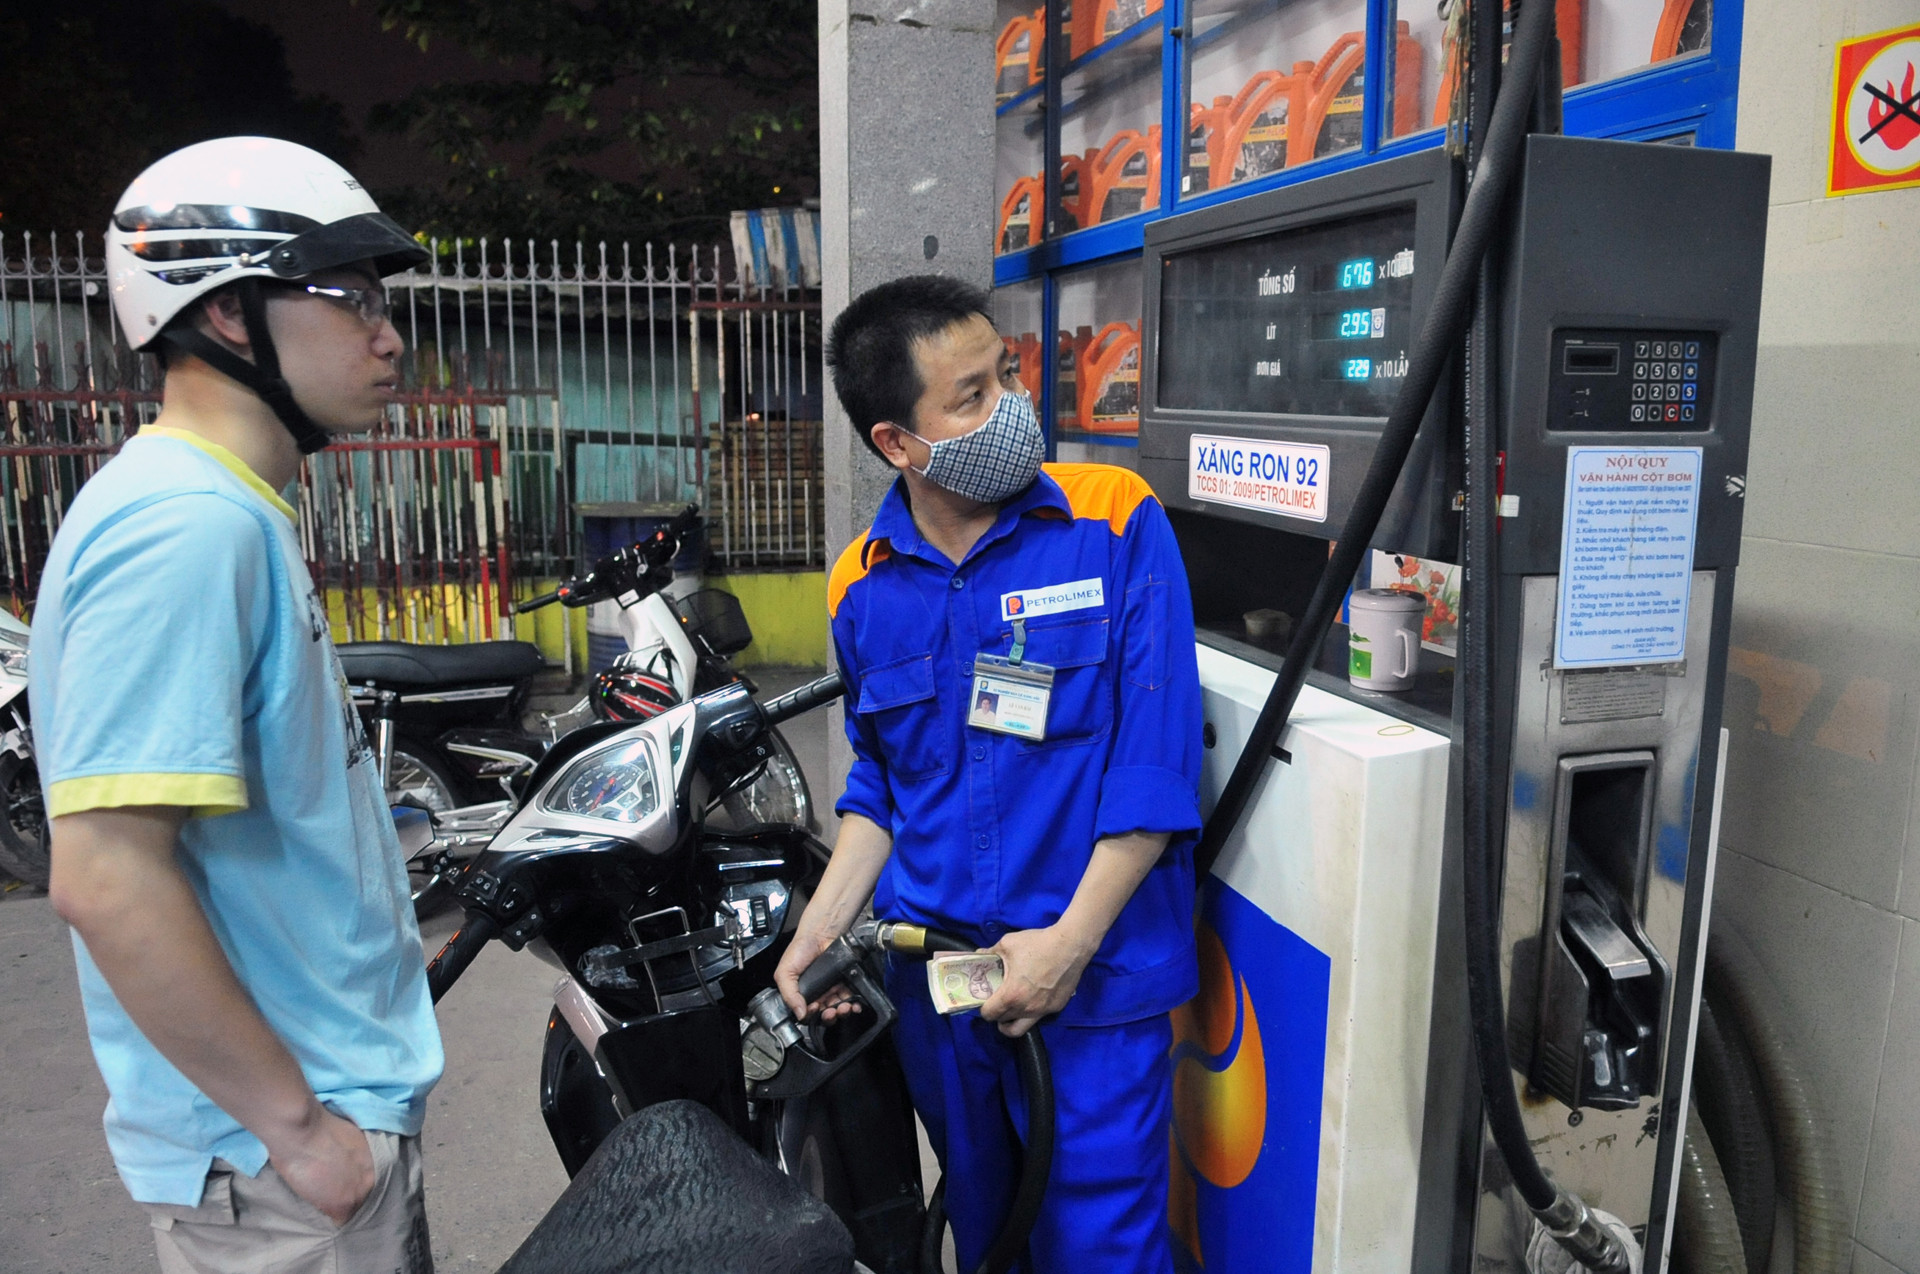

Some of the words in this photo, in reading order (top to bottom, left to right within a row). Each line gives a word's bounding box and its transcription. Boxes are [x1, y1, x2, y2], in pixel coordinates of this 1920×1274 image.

[1258, 268, 1280, 296] TỔNG
[1282, 266, 1296, 294] SỐ
[1342, 262, 1372, 288] 676
[1266, 322, 1276, 340] LÍT
[1639, 344, 1646, 355] 7
[1656, 344, 1662, 356] 8
[1672, 346, 1679, 356] 9
[1348, 359, 1370, 378] 229
[1637, 366, 1644, 376] 4
[1654, 366, 1661, 376] 5
[1671, 366, 1678, 376] 6
[1636, 387, 1642, 397] 1
[1652, 386, 1660, 397] 2
[1670, 386, 1676, 397] 3
[1686, 386, 1692, 397] S
[1634, 408, 1642, 418] 0
[1667, 406, 1676, 418] C
[1685, 408, 1690, 417] L
[1197, 442, 1244, 476] XĂNG
[1249, 452, 1289, 483] RON
[1296, 457, 1318, 487] 92
[1606, 454, 1634, 470] NỘI
[1638, 457, 1669, 470] QUY
[1580, 472, 1603, 484] VẬN
[1606, 472, 1638, 482] HÀNH
[1641, 472, 1664, 482] CỘT
[1667, 473, 1692, 482] BƠM
[1196, 475, 1218, 493] TCCS
[1219, 478, 1231, 496] 01:
[1233, 481, 1316, 510] 2009/PETROLIMEX
[1026, 588, 1102, 608] PETROLIMEX
